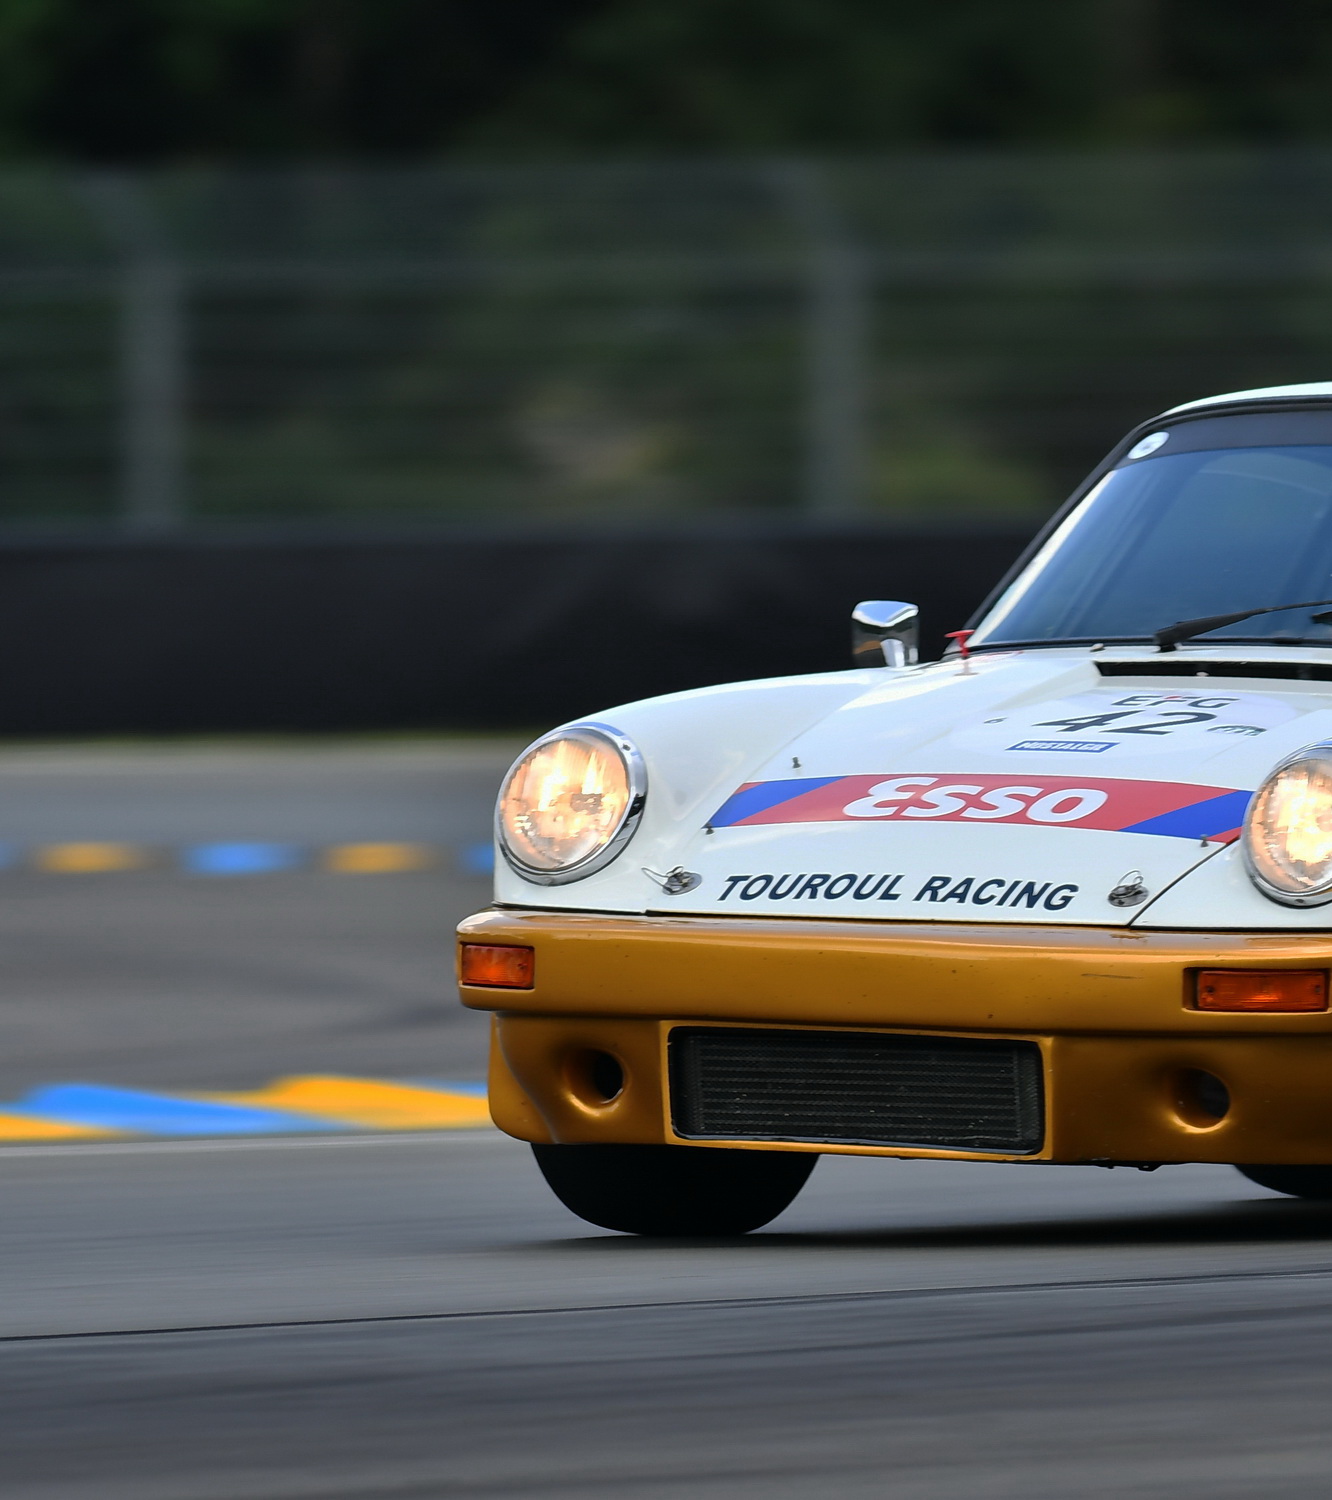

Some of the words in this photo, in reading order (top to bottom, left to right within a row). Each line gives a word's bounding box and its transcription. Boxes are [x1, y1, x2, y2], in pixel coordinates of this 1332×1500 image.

[1111, 695, 1240, 708] EFG
[1031, 710, 1217, 735] 42
[718, 873, 905, 902] TOUROUL
[914, 875, 1079, 911] RACING
